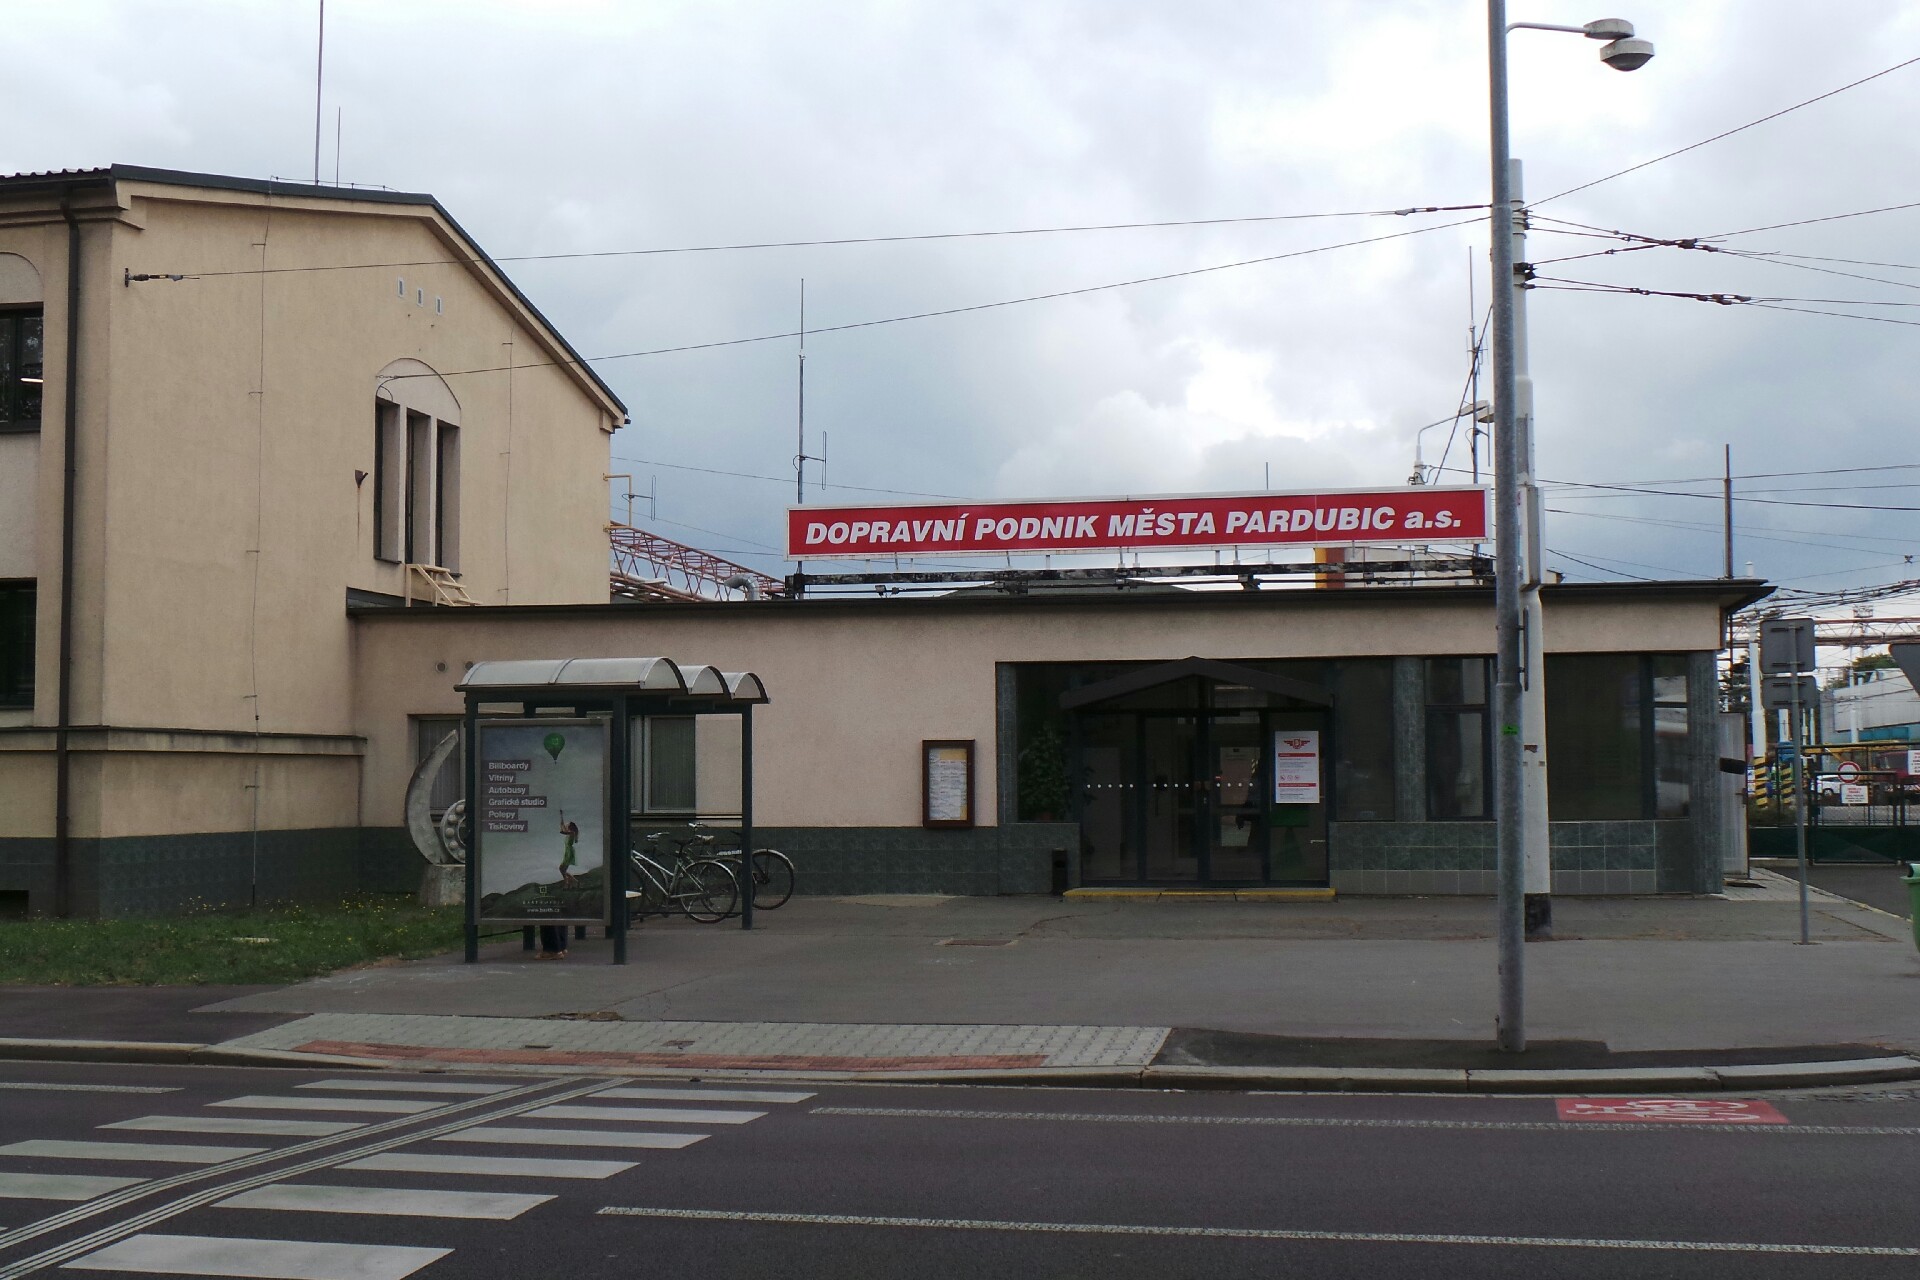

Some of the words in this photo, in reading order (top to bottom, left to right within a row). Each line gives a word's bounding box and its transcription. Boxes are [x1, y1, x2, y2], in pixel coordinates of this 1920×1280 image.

[805, 513, 969, 545] DOPRAVNÍ
[975, 516, 1099, 541] PODNIK
[1107, 507, 1216, 537] MĚSTA
[1225, 506, 1396, 534] PARDUBIC
[1404, 510, 1462, 529] a.s.
[488, 761, 529, 771] Billboardy
[488, 786, 526, 795] Autobusy
[488, 798, 520, 806] Grafické
[520, 798, 545, 806] studio
[488, 810, 516, 819] Polepy
[488, 822, 525, 831] Tiskoviny
